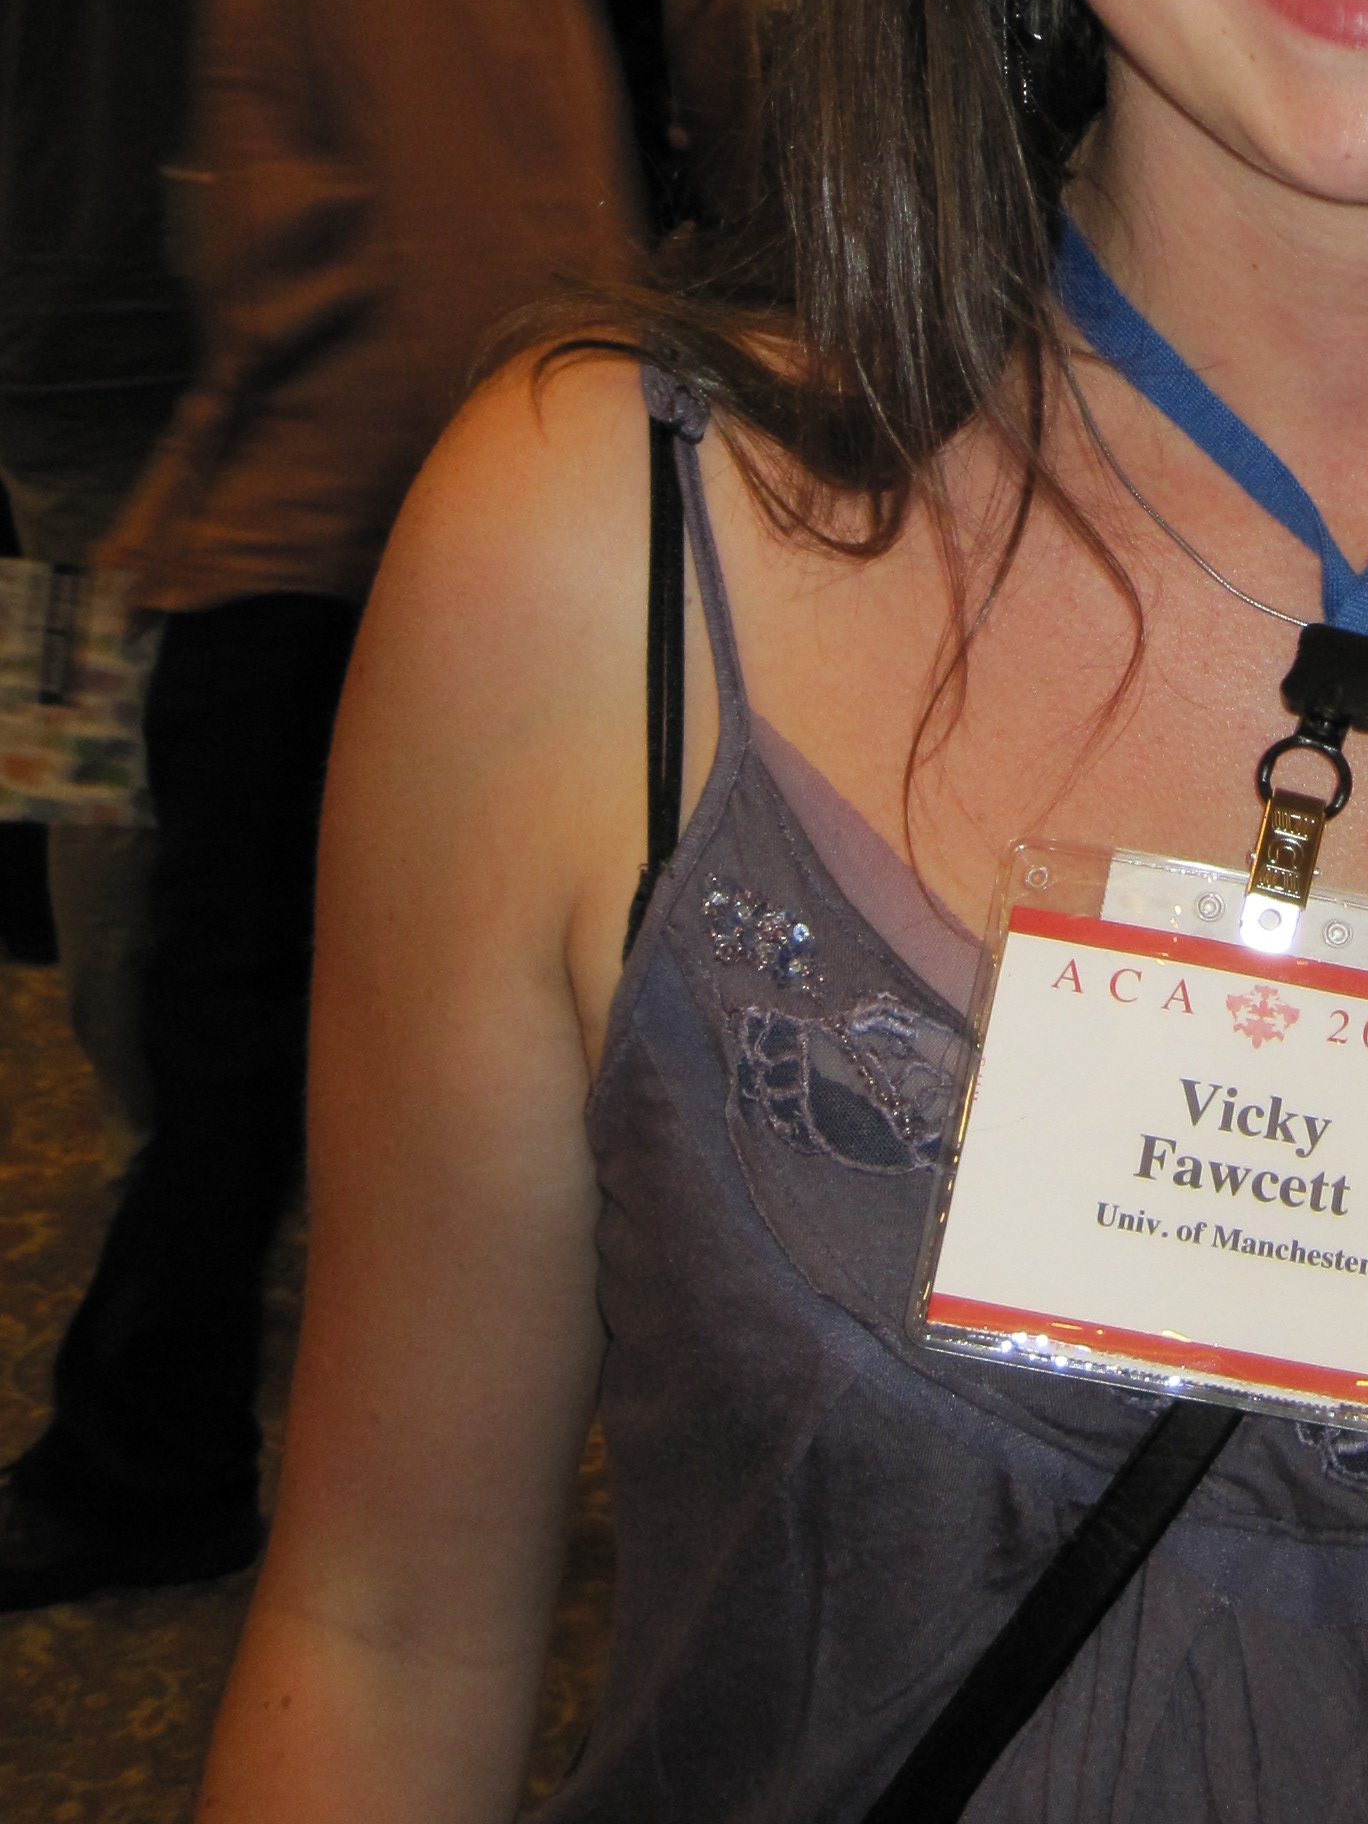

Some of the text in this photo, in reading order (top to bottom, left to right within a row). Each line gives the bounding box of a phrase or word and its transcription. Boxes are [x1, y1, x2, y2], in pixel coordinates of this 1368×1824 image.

[1051, 958, 1194, 1015] ACA
[1179, 1078, 1333, 1159] Vicky
[1133, 1134, 1351, 1217] Fawcett
[1096, 1202, 1168, 1239] Univ.
[1176, 1221, 1208, 1245] of
